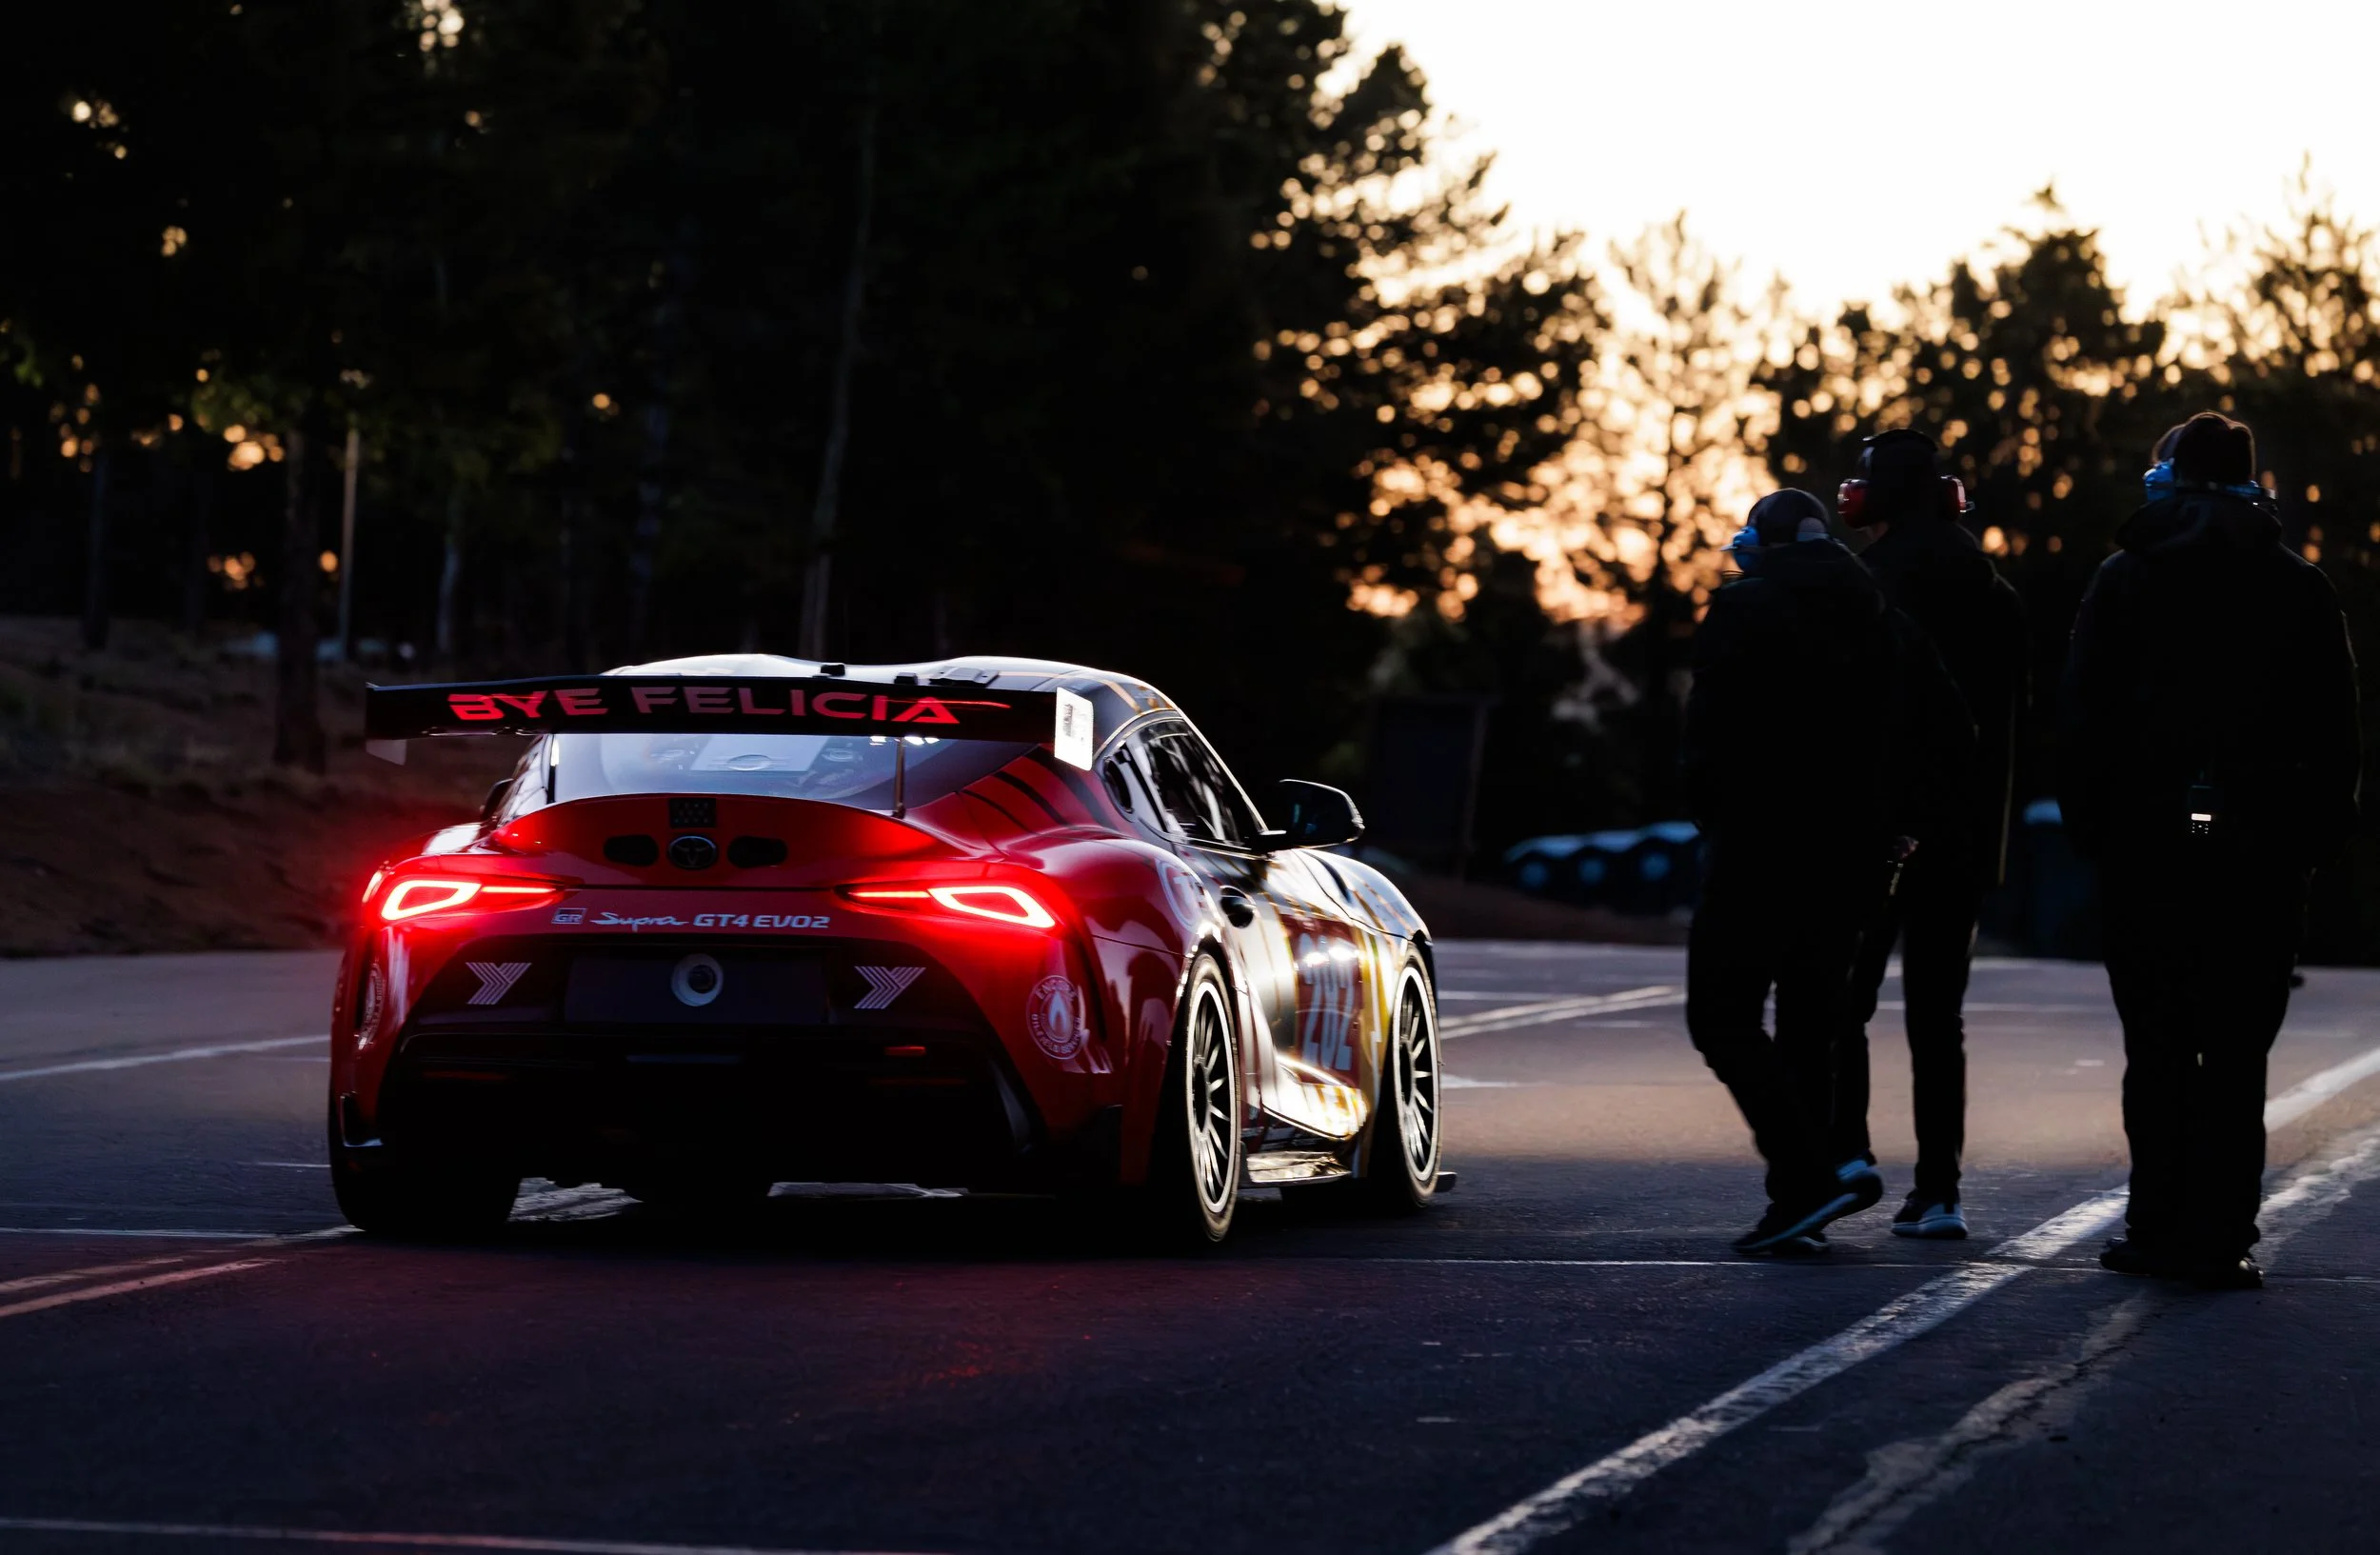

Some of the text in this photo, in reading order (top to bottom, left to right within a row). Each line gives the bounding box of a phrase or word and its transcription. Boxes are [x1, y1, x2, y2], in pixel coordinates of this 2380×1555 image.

[446, 686, 961, 724] BYE FELICIA
[552, 911, 831, 932] GR Supra GT4 EVO2
